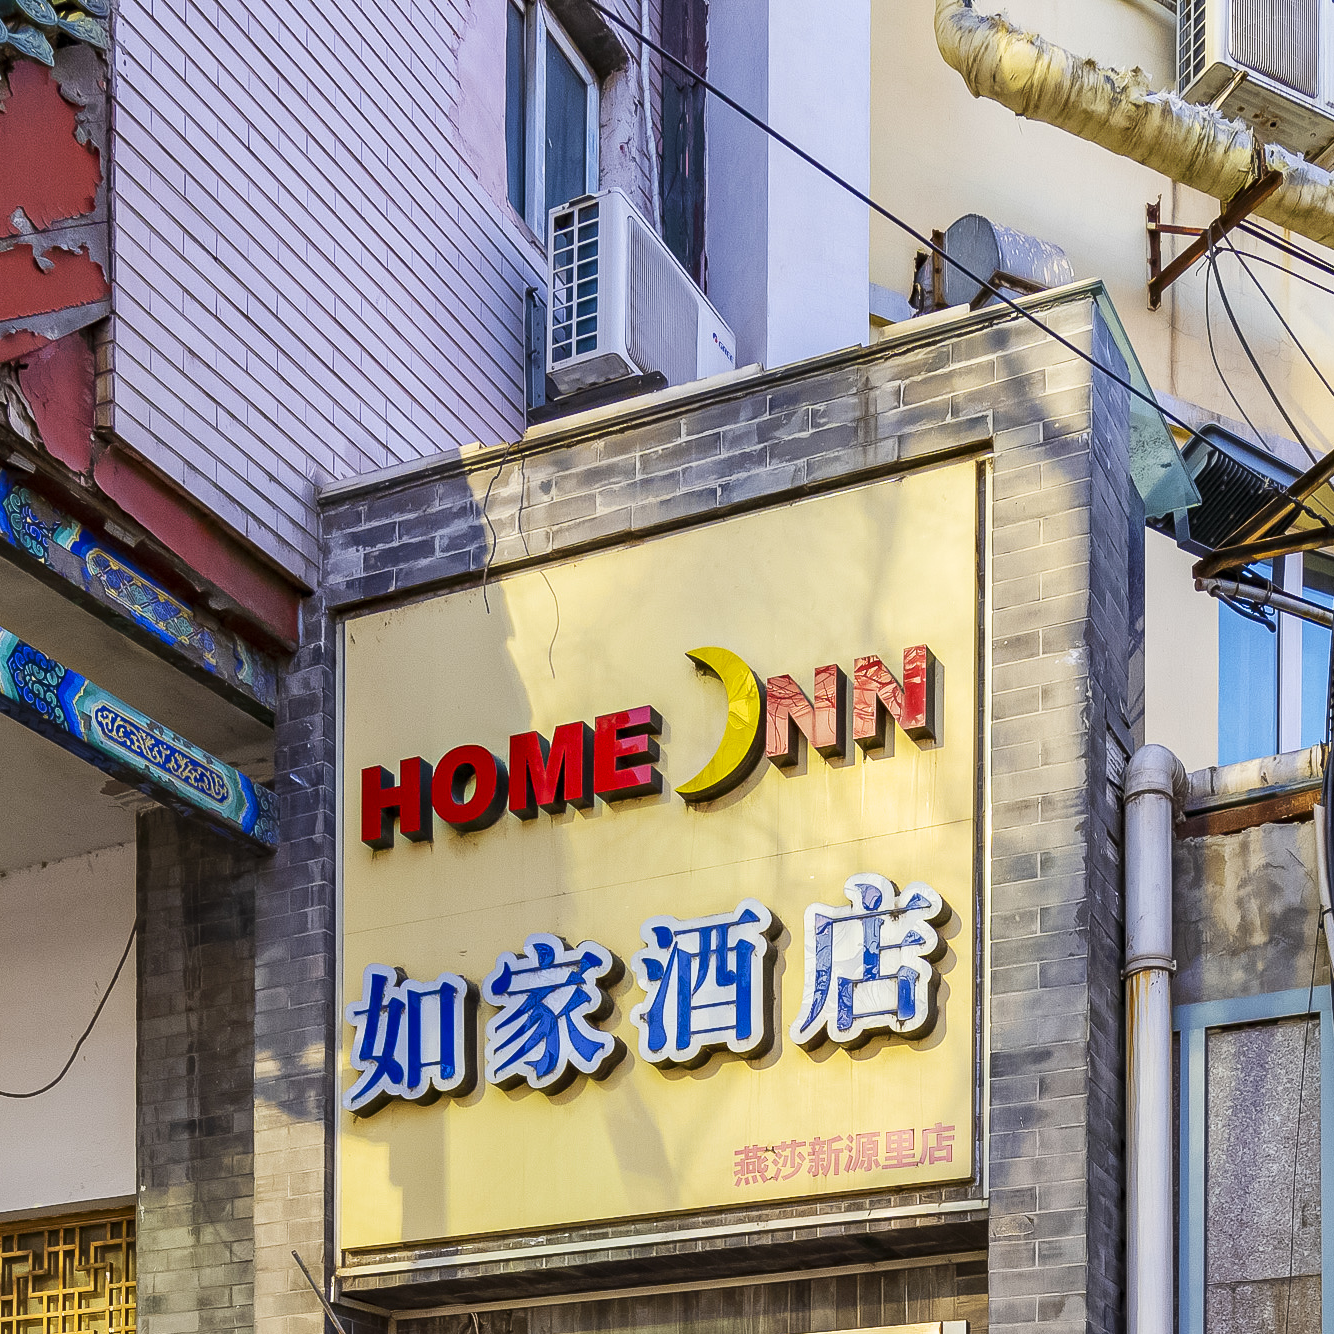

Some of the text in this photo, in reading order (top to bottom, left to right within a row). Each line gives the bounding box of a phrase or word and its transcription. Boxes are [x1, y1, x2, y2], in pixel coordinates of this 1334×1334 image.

[361, 704, 661, 850] HOME
[343, 872, 949, 1116] 如家酒店
[733, 1122, 956, 1188] 燕莎新源里店
